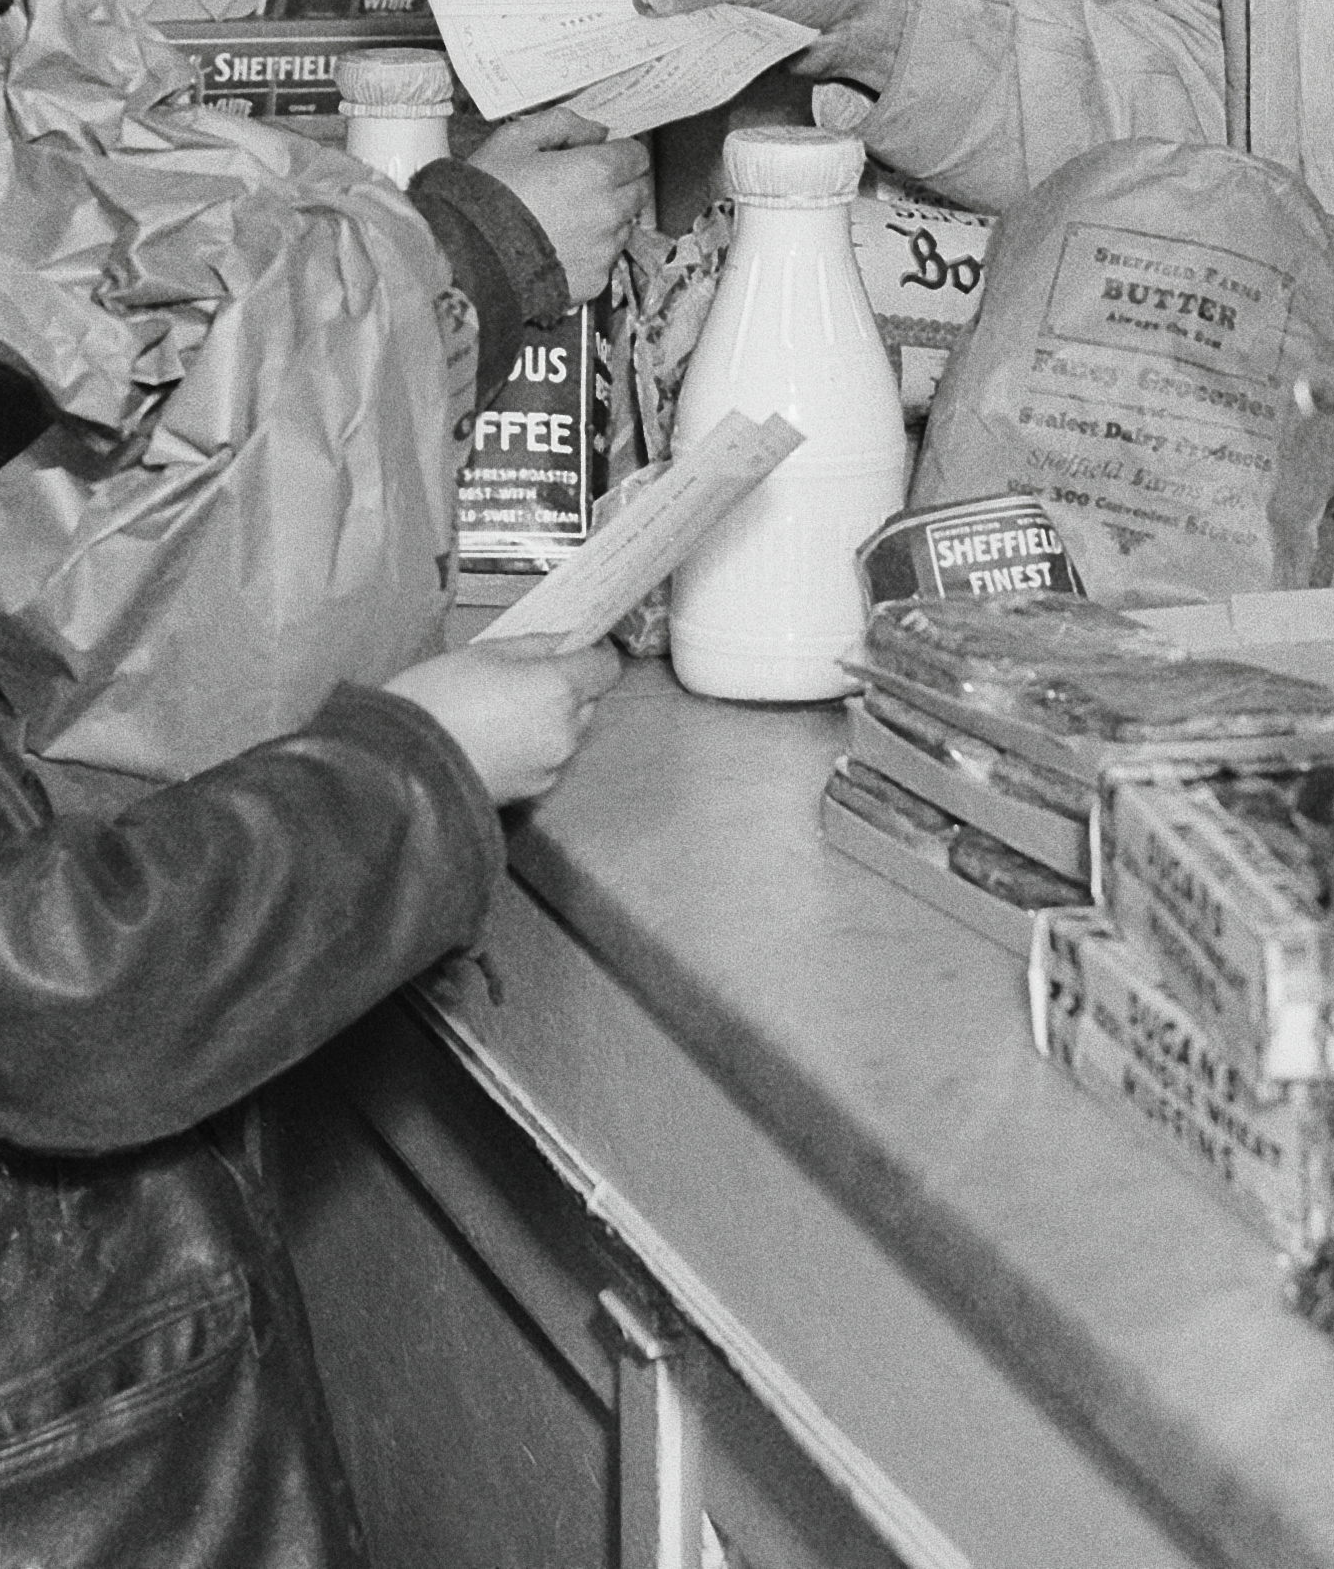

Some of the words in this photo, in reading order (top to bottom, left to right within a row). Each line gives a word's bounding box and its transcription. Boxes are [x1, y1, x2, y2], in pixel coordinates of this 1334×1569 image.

[1100, 276, 1238, 331] BUTTER
[475, 411, 574, 455] FFEE
[1050, 485, 1090, 506] 300
[937, 528, 1063, 569] SHEFFIELD
[969, 561, 1052, 597] FINEST
